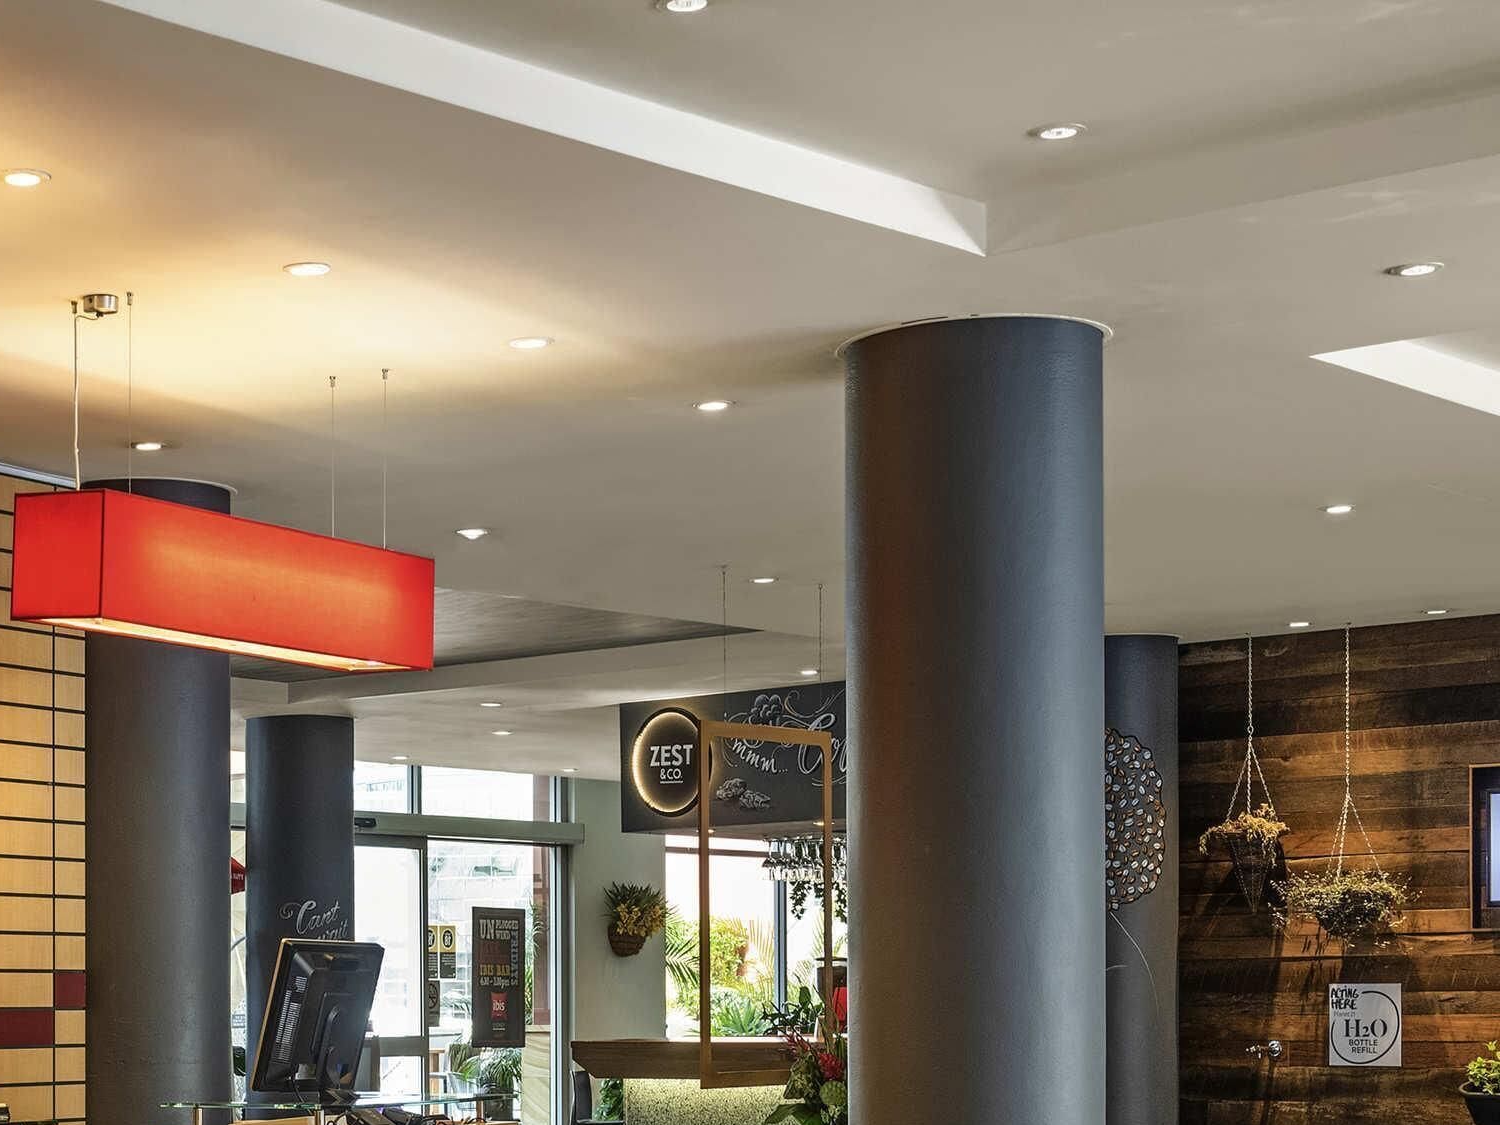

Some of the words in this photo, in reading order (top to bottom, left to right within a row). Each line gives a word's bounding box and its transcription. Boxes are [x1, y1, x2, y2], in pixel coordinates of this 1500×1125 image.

[650, 744, 693, 766] ZEST
[1331, 999, 1357, 1010] HERE
[1349, 1039, 1378, 1047] BOTTLE
[1352, 1046, 1377, 1054] REFILL
